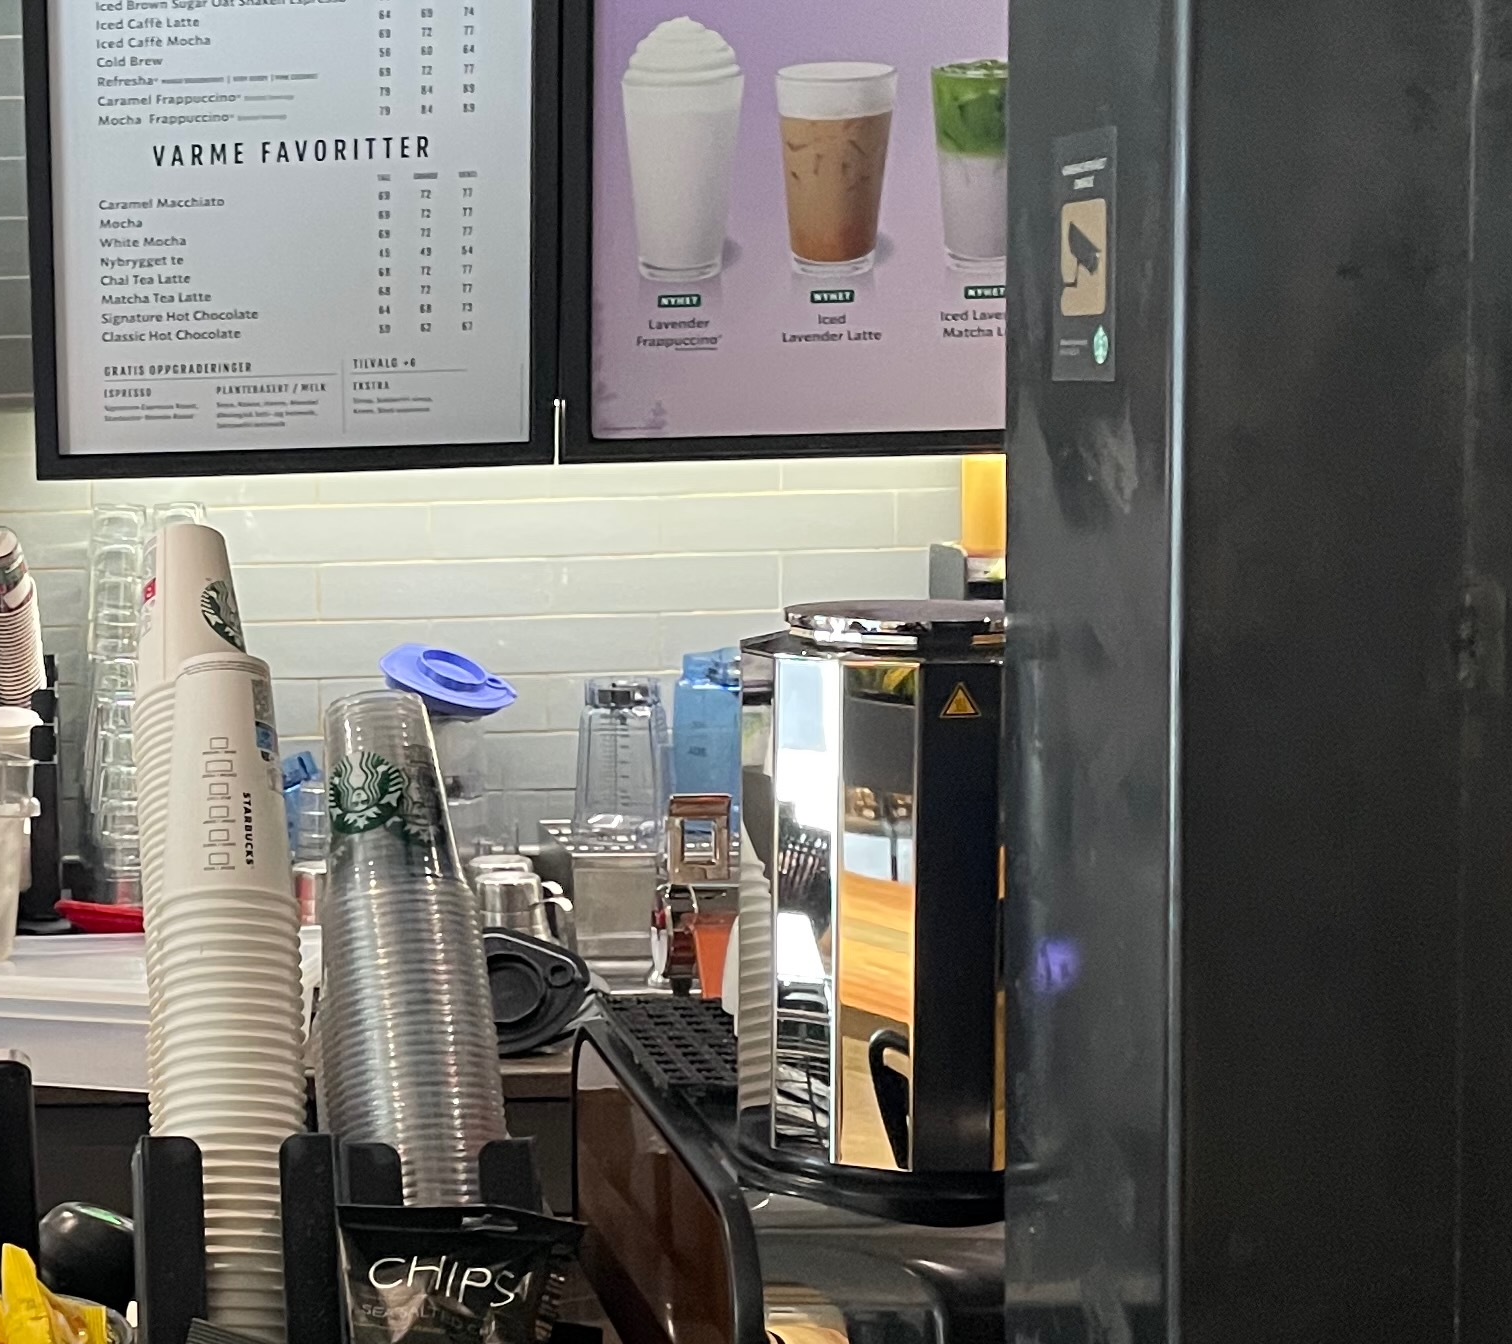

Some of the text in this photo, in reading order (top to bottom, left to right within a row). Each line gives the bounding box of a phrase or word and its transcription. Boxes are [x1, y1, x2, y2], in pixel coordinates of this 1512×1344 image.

[96, 2, 122, 11] Iced
[127, 0, 167, 10] Brown
[172, 0, 207, 10] Sugar
[96, 20, 123, 30] Iced
[167, 18, 199, 27] Latte
[96, 39, 123, 49] Iced
[167, 36, 211, 46] Mocha
[97, 56, 163, 67] Cold Brew
[98, 95, 151, 106] Caramel
[99, 115, 141, 125] Mocha
[153, 136, 430, 166] VARME FAVORITTER
[99, 198, 224, 210] Caramel Macchiato
[100, 219, 142, 228] Mocha
[100, 236, 186, 247] White Mocha
[101, 257, 183, 268] Nybrygget te
[133, 275, 154, 285] Tea
[158, 274, 190, 284] Latte
[102, 293, 211, 304] Matcha Tea Latte
[102, 309, 258, 325] Signature Hot Chocolate
[818, 315, 846, 324] Iced
[940, 311, 968, 322] Iced
[648, 319, 709, 330] Lavender
[102, 329, 241, 342] Classic Hot Chocolate
[783, 330, 881, 343] Lavender Latte
[943, 327, 993, 338] Matcha
[354, 358, 398, 369] TILVALG
[105, 363, 252, 377] GRATIS OPPGRADERINGER
[243, 792, 254, 865] STARBUCKS
[369, 1256, 516, 1308] CHIPS
